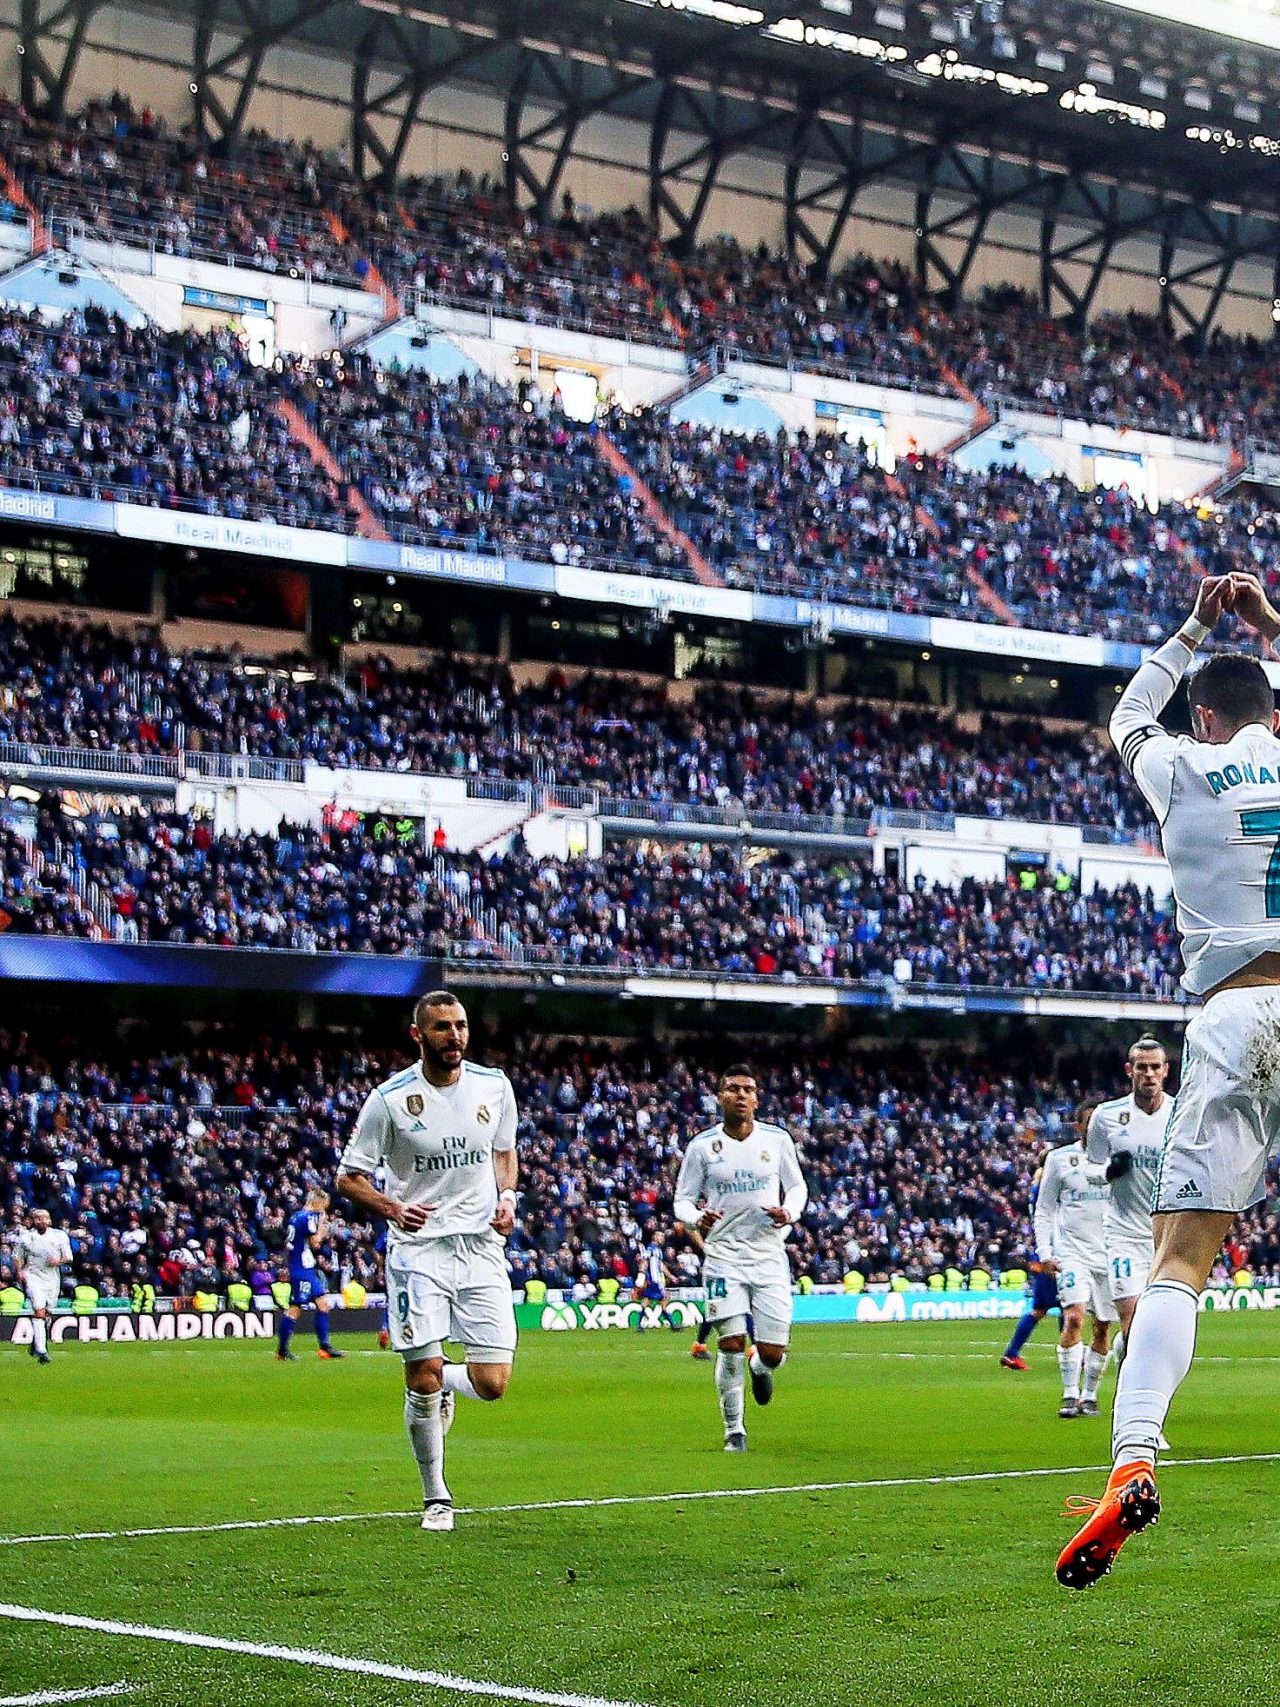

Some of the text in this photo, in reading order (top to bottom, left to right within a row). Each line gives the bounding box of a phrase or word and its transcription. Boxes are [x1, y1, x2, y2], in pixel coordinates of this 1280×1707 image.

[401, 547, 506, 580] Real Madrid
[1112, 1257, 1132, 1279] 11
[398, 1291, 409, 1322] 9
[911, 1297, 1026, 1321] movistar
[51, 1311, 274, 1344] CHAMPION
